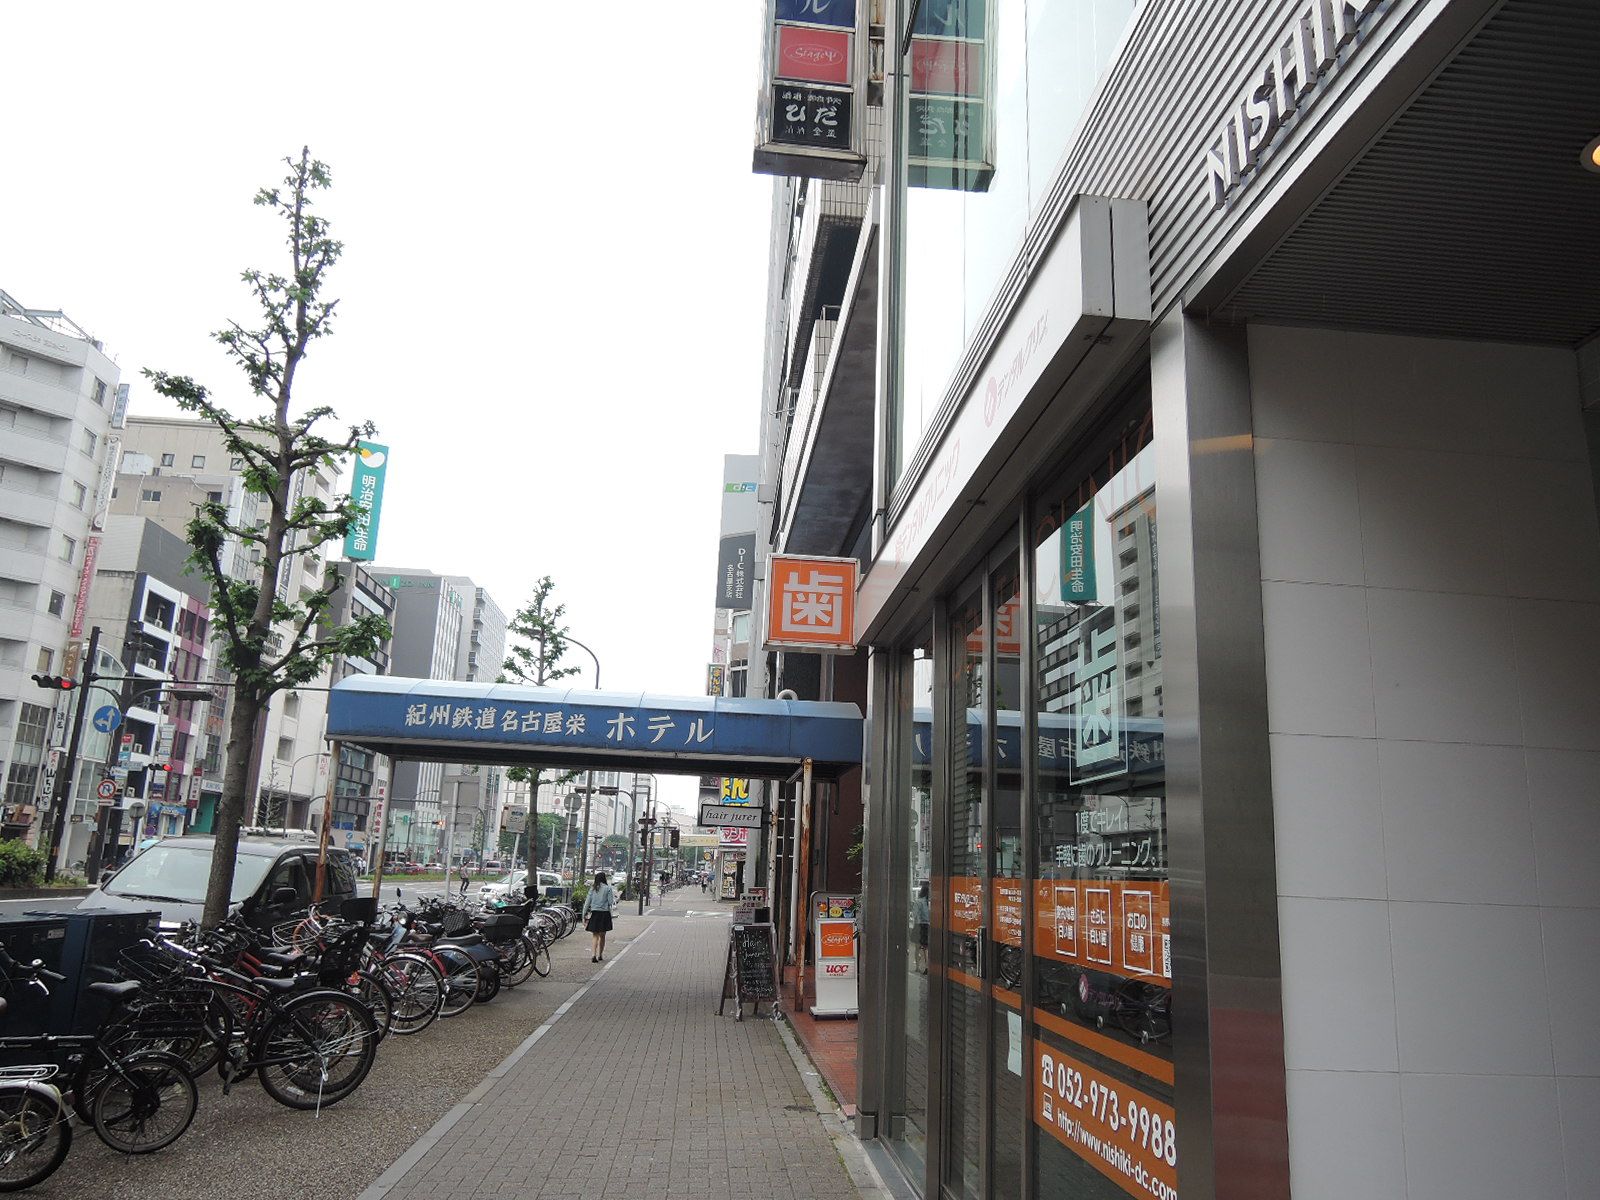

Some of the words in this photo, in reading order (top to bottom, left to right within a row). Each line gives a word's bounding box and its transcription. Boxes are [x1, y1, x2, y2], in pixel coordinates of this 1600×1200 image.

[785, 104, 838, 126] ひだ
[783, 571, 842, 634] 歯
[1075, 625, 1119, 768] 歯
[405, 702, 586, 736] 紀州鉄道名古屋栄
[606, 711, 715, 745] ホテル
[705, 808, 729, 820] hair
[1126, 911, 1147, 931] お口の
[1057, 1062, 1178, 1167] 052-973-9988
